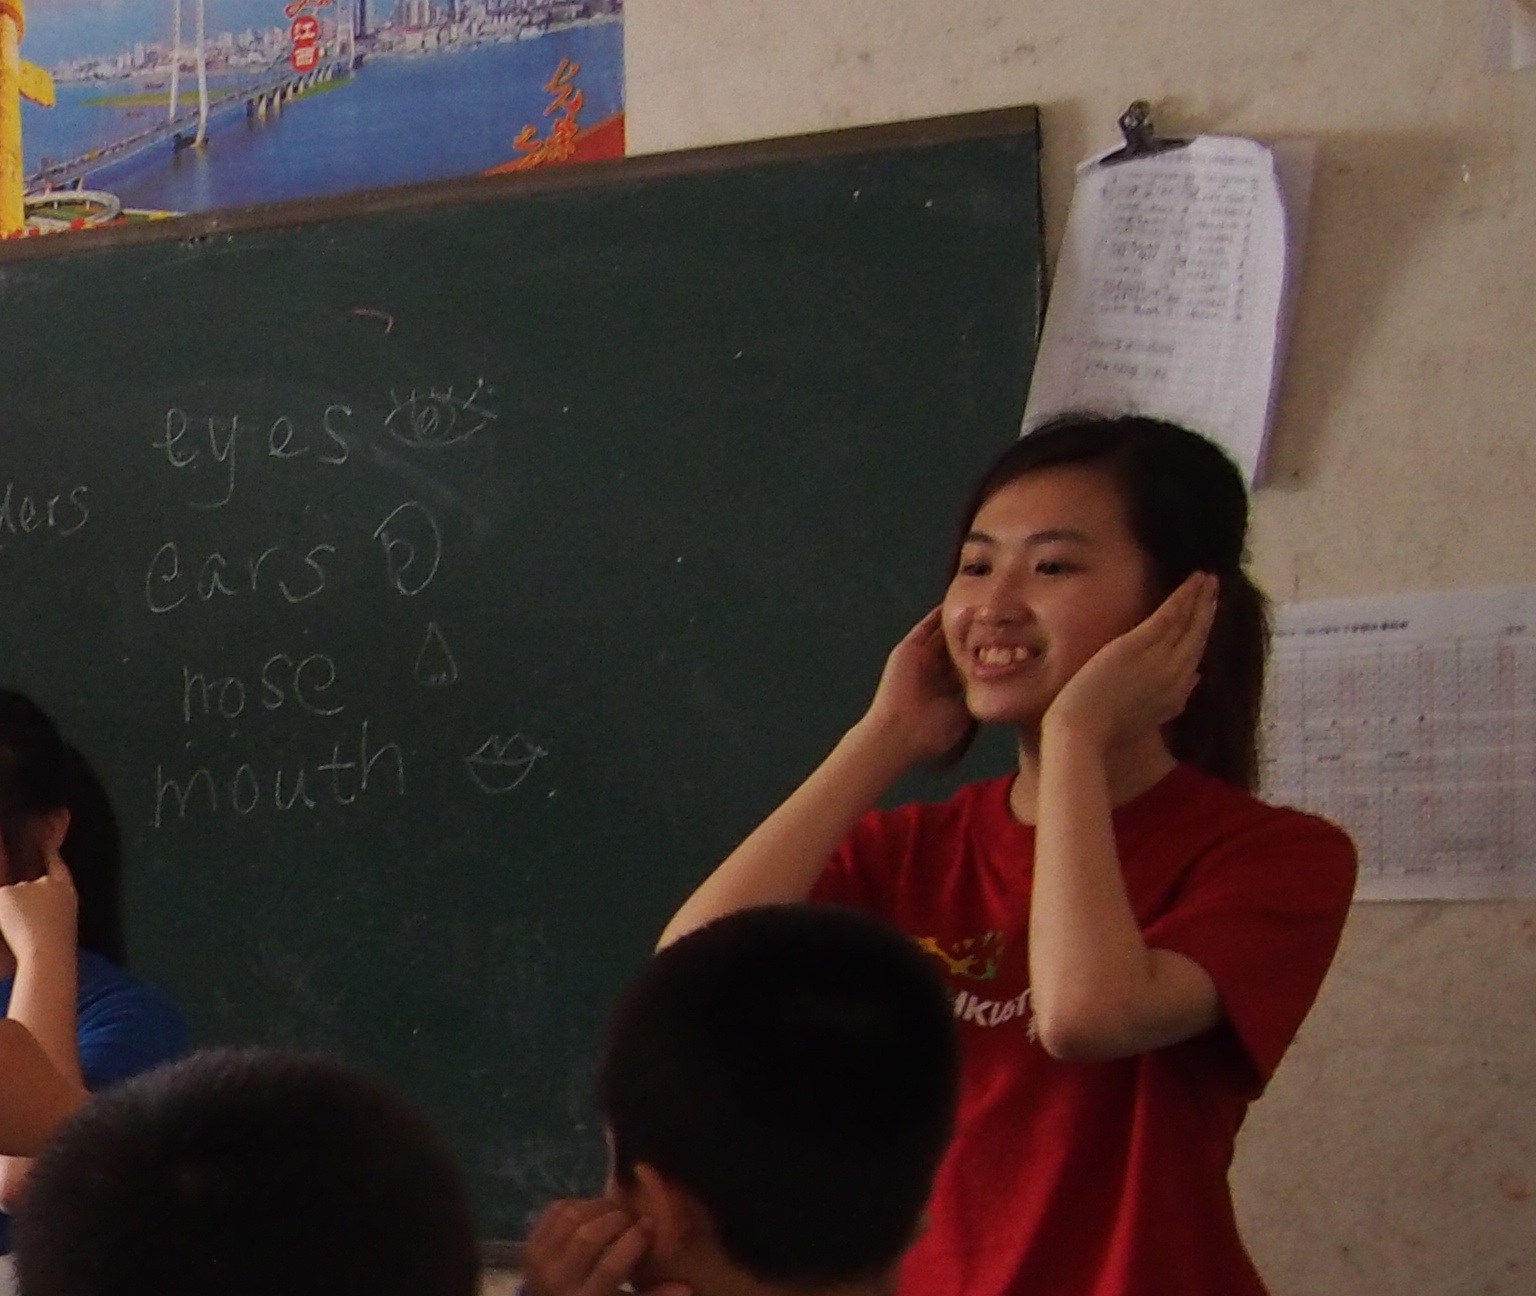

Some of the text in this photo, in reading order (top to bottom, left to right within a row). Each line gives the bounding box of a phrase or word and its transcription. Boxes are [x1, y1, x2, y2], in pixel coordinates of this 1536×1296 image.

[153, 403, 352, 508] eyes
[146, 542, 336, 613] ears
[184, 653, 345, 722] nose
[155, 721, 405, 828] mouth
